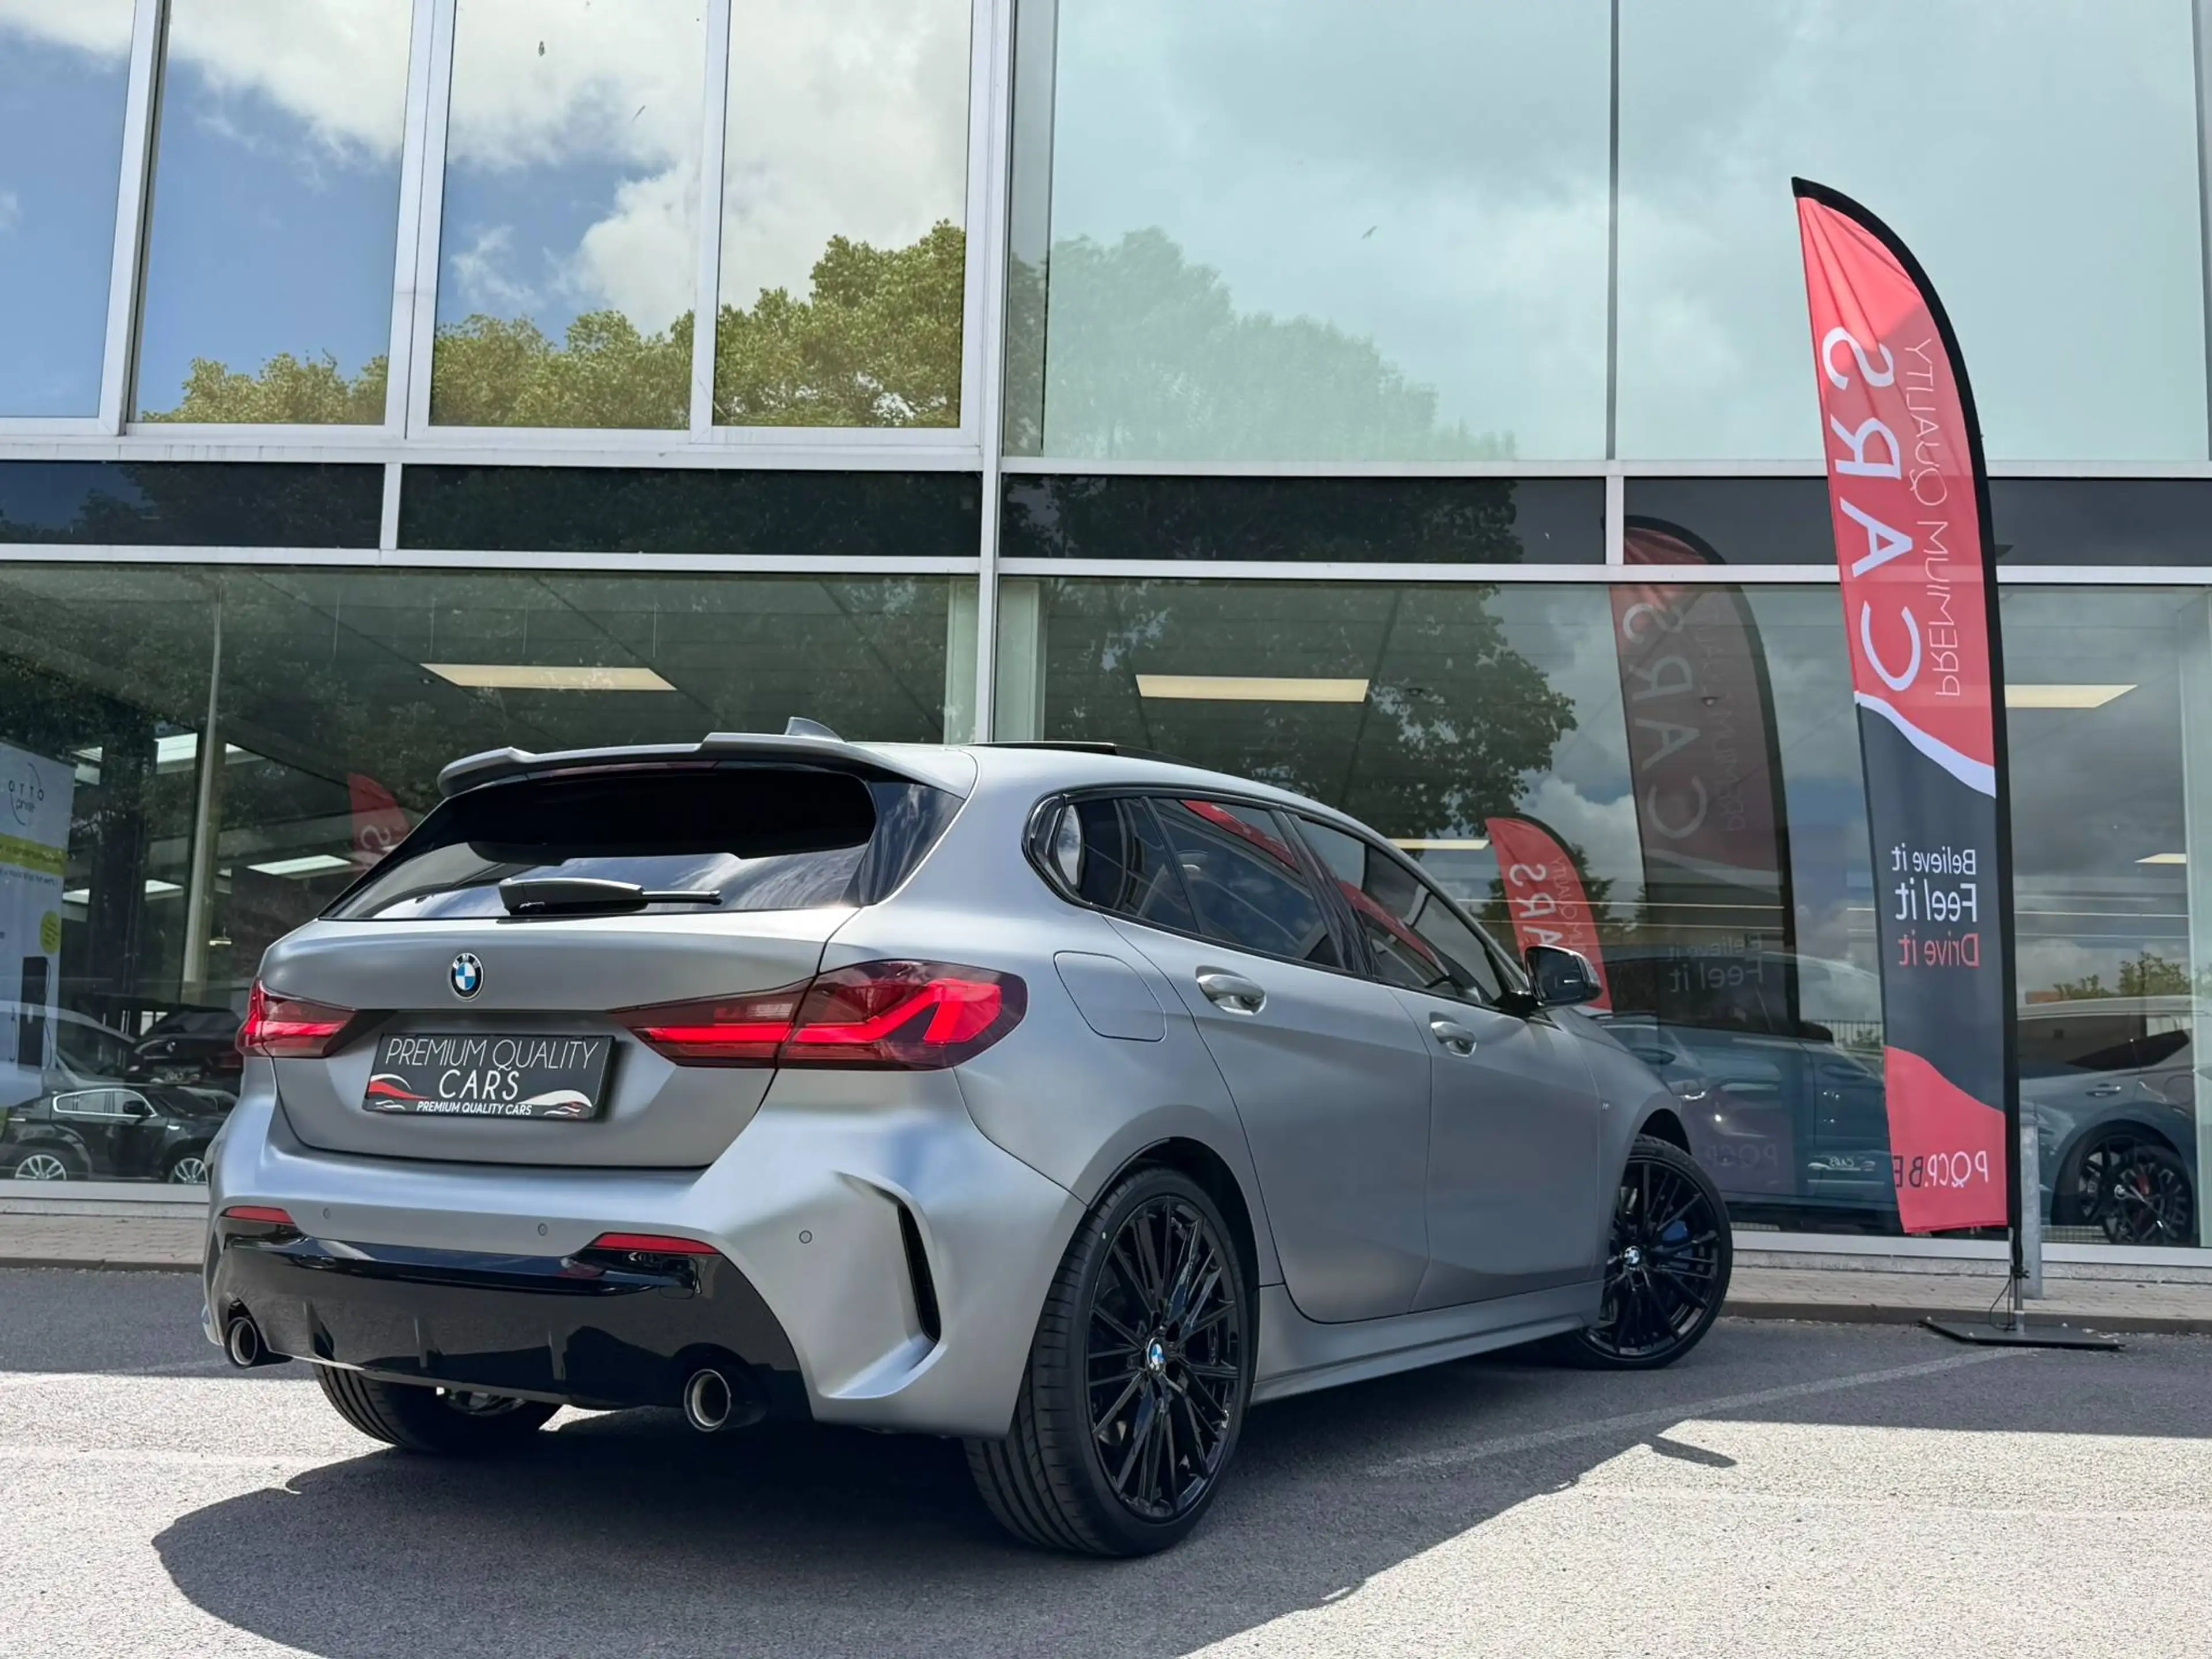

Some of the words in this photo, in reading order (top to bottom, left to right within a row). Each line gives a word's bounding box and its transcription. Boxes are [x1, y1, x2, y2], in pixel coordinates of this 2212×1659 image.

[384, 1037, 487, 1067] PREMIUM
[492, 1039, 599, 1071] QUALITY
[438, 1068, 520, 1101] CARS
[416, 1101, 460, 1114] PREMIUM
[461, 1101, 503, 1116] QUALITY
[505, 1103, 532, 1116] CARS
